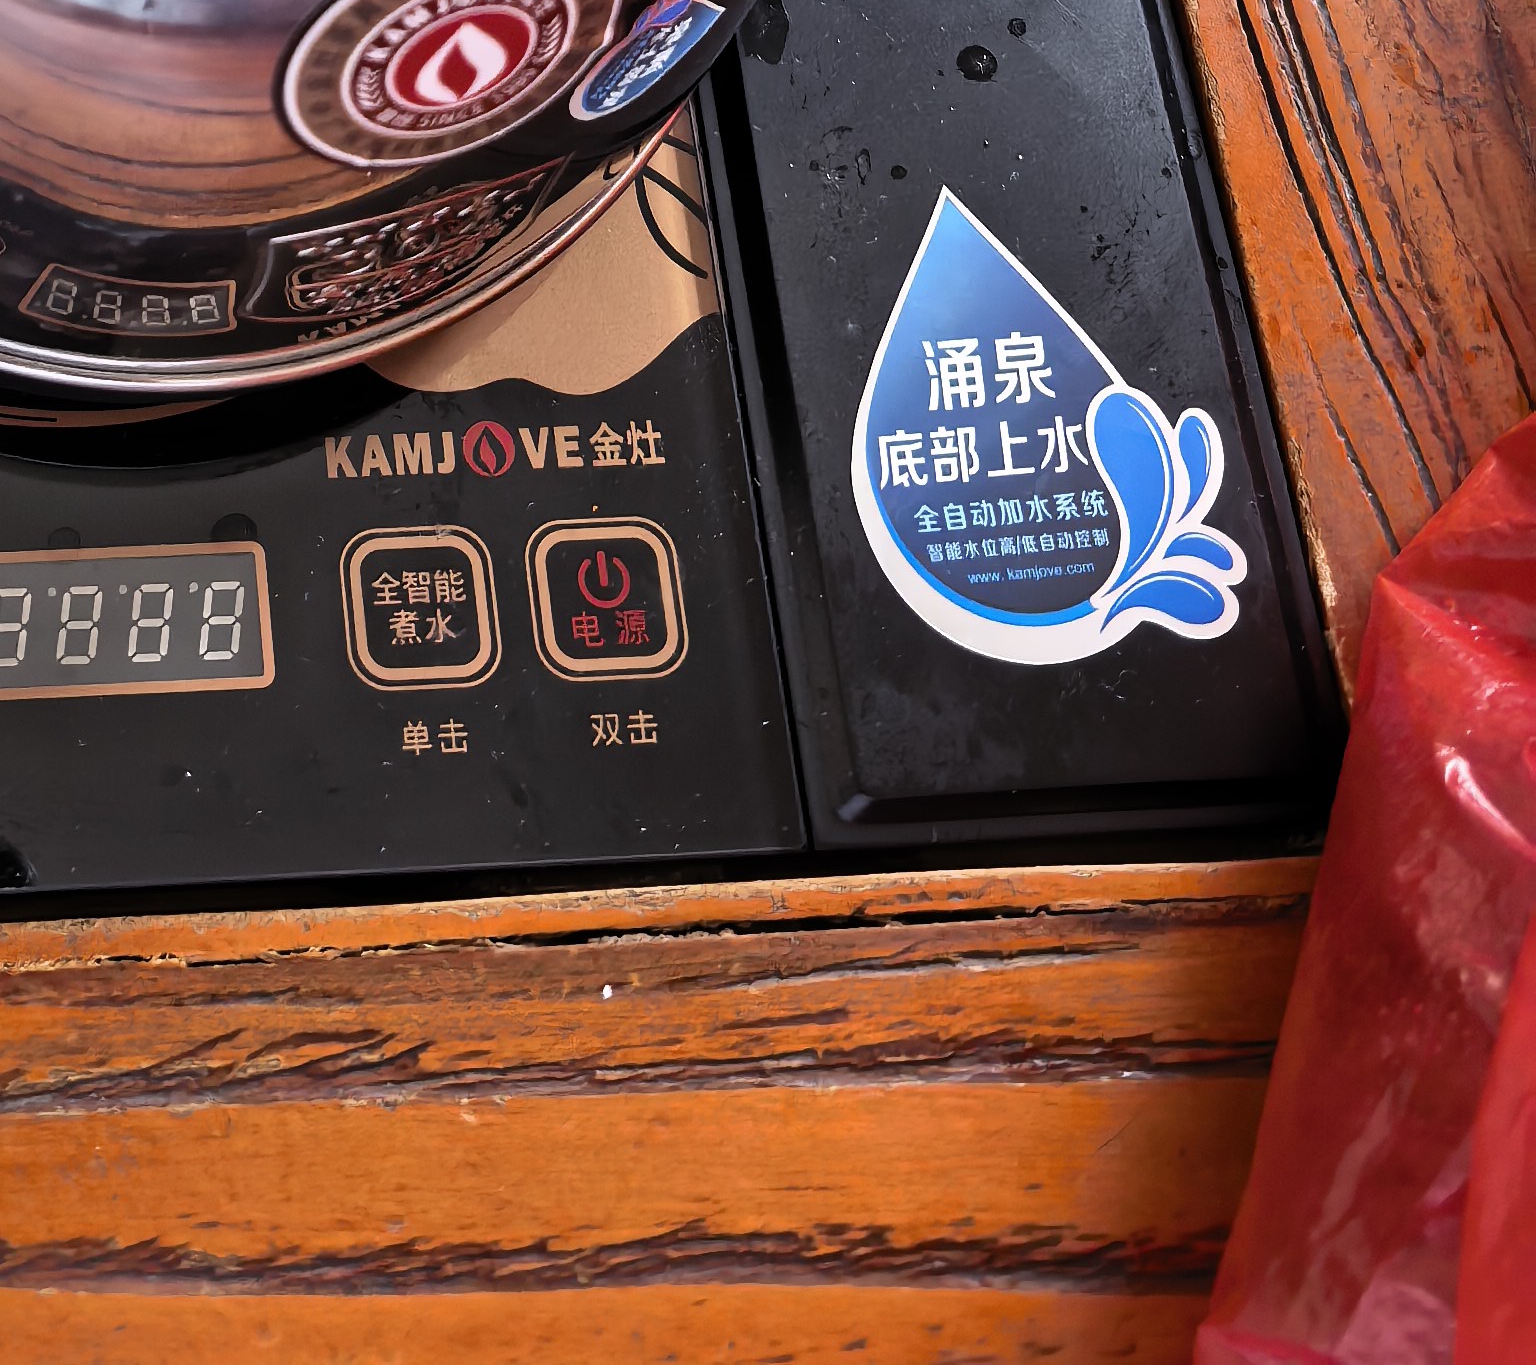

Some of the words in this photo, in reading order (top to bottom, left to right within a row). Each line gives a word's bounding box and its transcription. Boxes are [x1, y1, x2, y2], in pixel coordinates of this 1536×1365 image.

[920, 331, 1057, 413] 涌泉
[876, 414, 1090, 491] 底部上水
[912, 488, 1110, 535] 全自动加水系统
[926, 527, 1111, 563] 智能水位高/低自动控制
[371, 569, 468, 606] 全智能
[388, 608, 462, 646] 煮水
[571, 610, 651, 648] 电源
[400, 717, 470, 757] 单击
[589, 709, 659, 747] 双击
